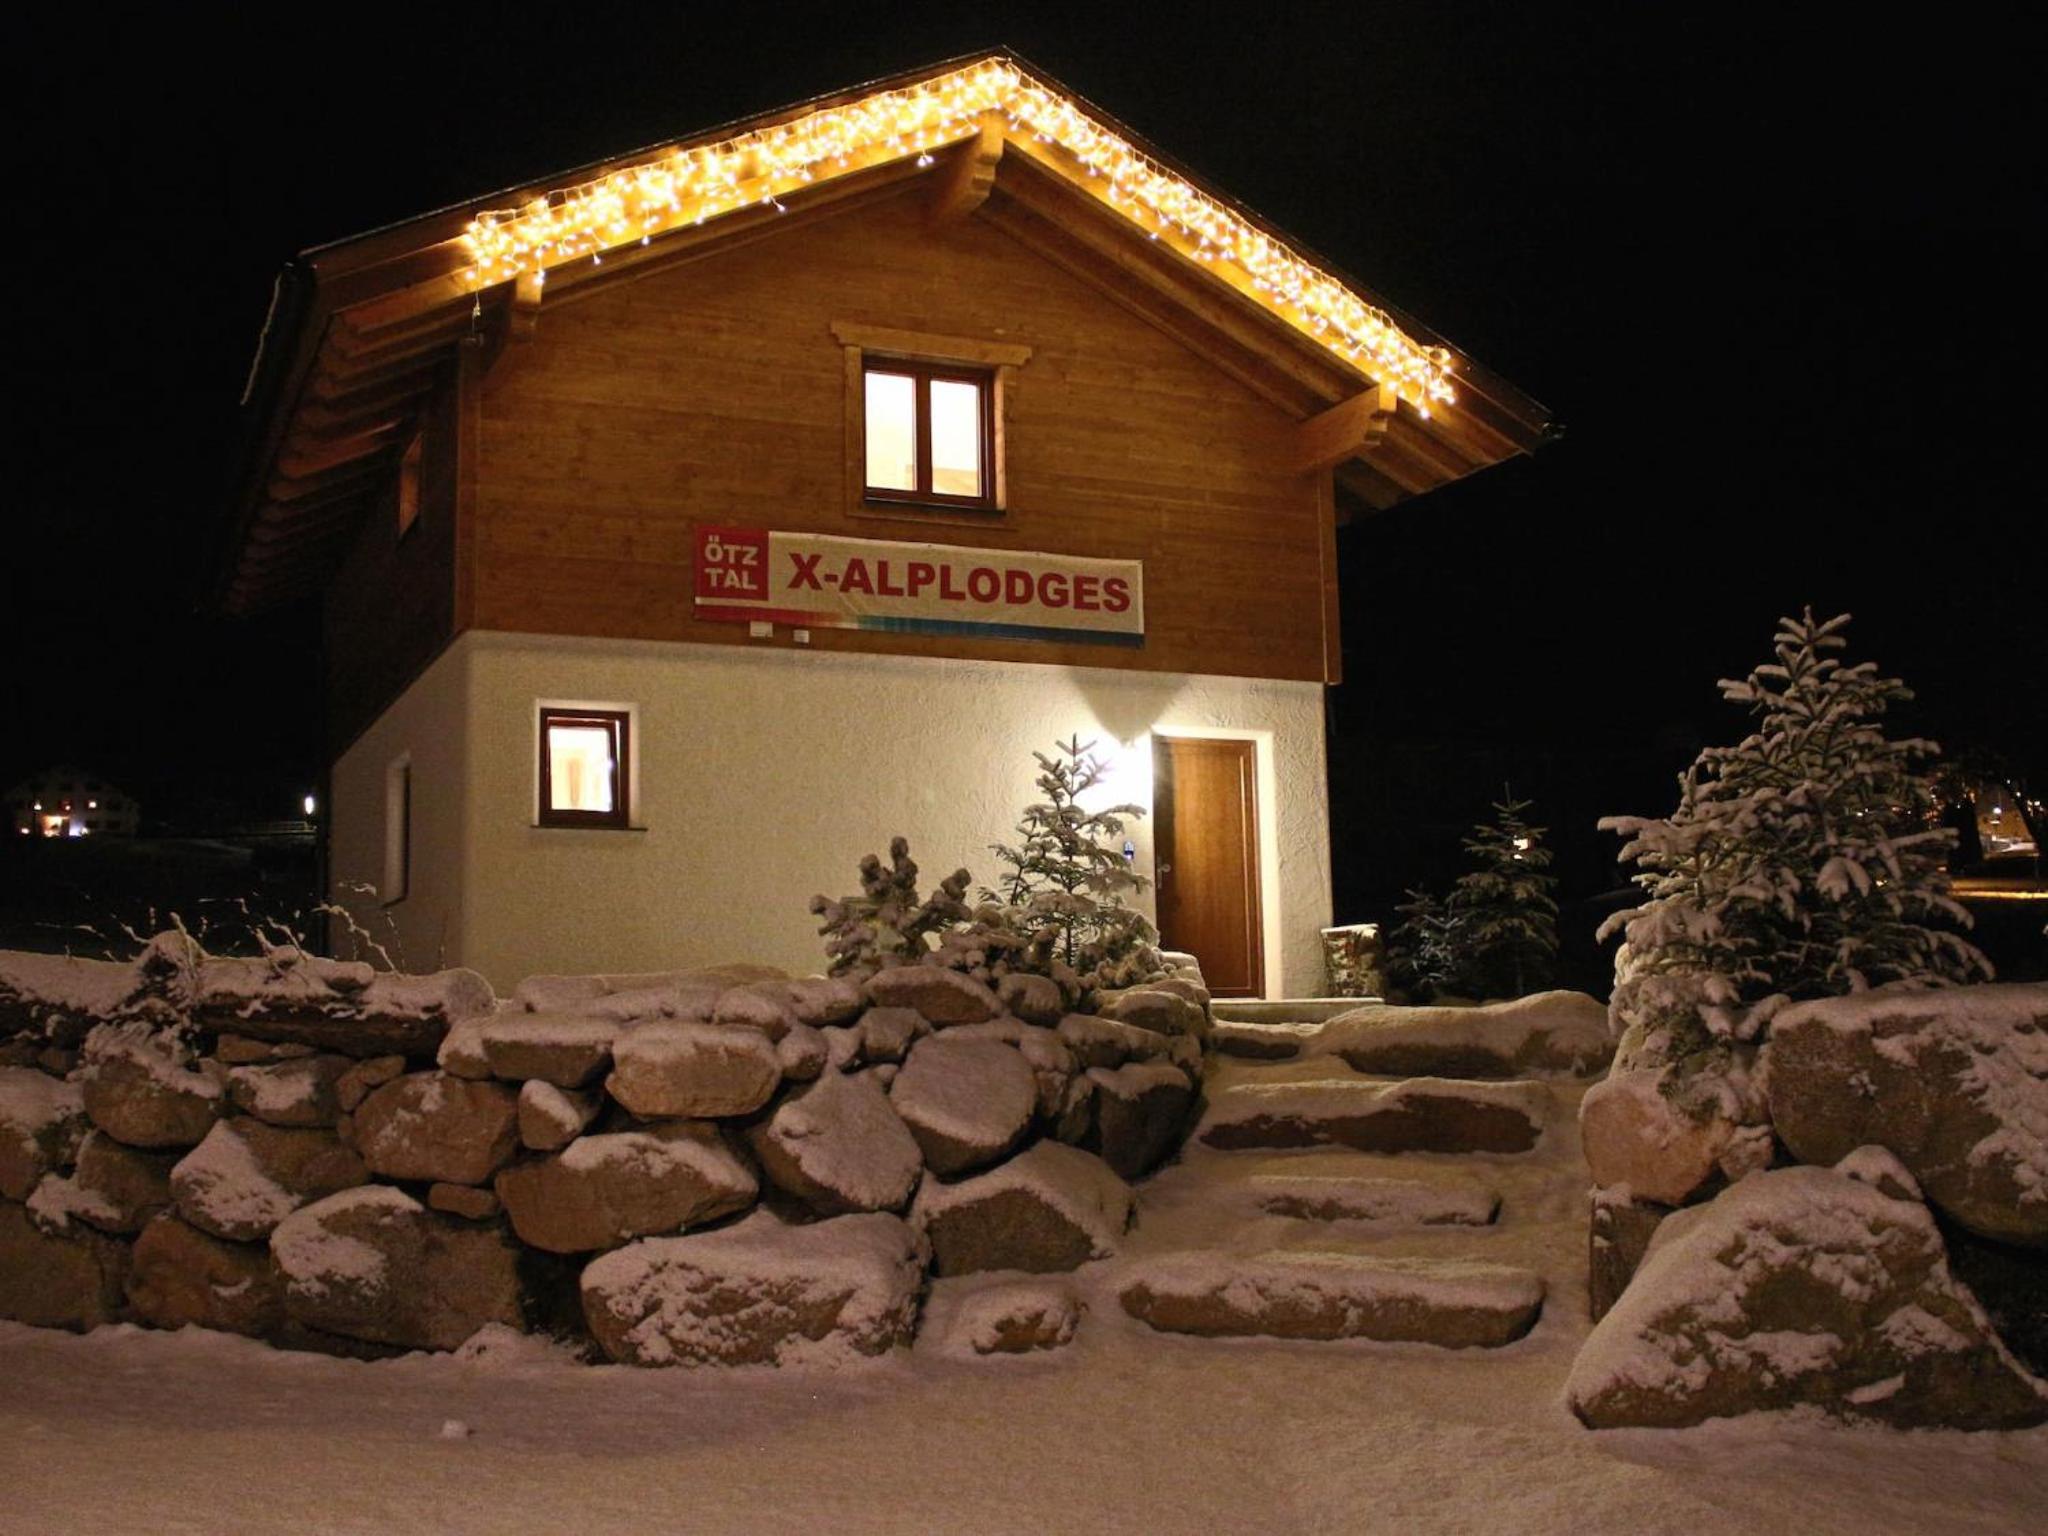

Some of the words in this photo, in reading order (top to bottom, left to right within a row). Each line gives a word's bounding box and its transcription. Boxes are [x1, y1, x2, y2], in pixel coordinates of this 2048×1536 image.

[705, 535, 758, 565] ÖTZ
[705, 567, 758, 590] TAL
[787, 552, 1130, 612] X-ALPLODGES
